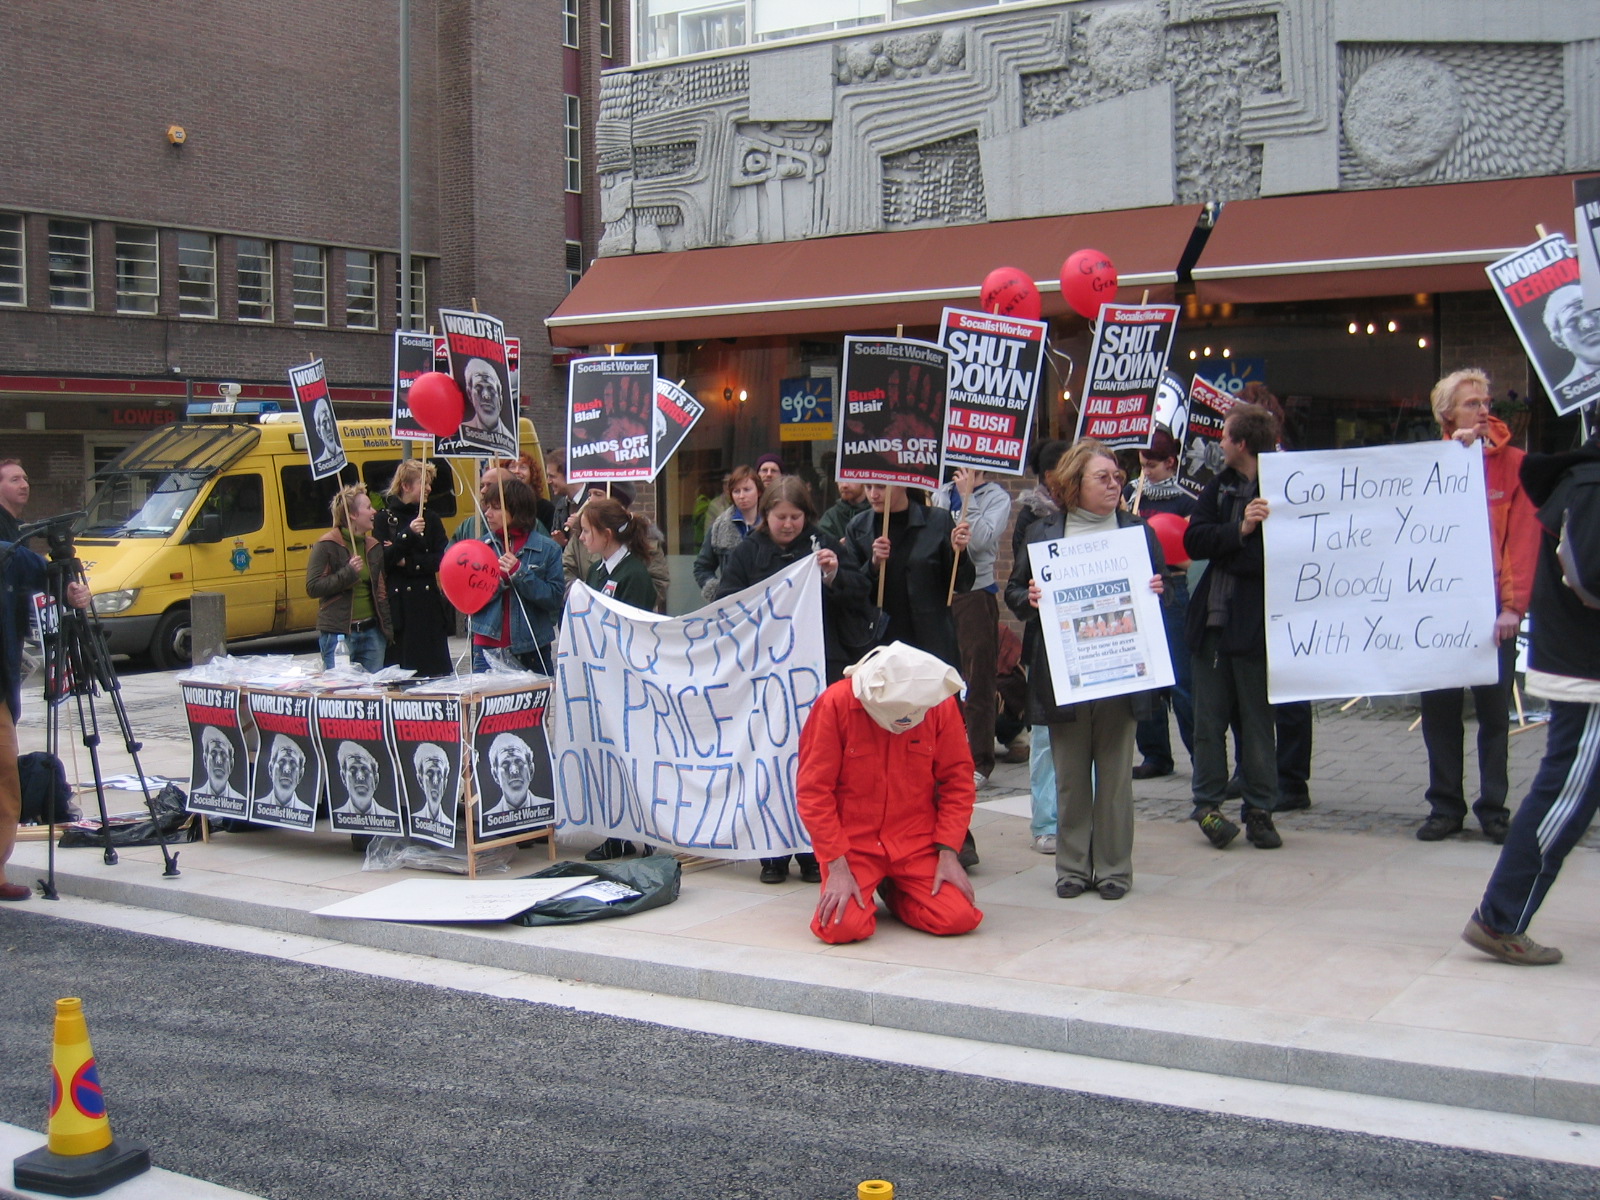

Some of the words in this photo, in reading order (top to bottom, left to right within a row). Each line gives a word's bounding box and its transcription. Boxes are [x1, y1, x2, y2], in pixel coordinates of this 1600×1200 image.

[445, 315, 493, 340] WORLD'S
[1101, 325, 1160, 353] SHUT
[855, 343, 903, 356] Socialist
[904, 345, 943, 363] Worker
[949, 331, 1026, 369] SHUT
[578, 362, 615, 373] Socialist
[616, 361, 649, 371] Worker
[1094, 352, 1163, 381] DOWN
[1141, 379, 1156, 388] BAY
[574, 398, 604, 412] Bush
[848, 388, 885, 402] Bush
[1007, 398, 1028, 410] BAY
[211, 403, 234, 413] POLICE
[574, 409, 601, 423] Blair
[683, 401, 698, 416] #1
[781, 391, 816, 422] ego
[849, 400, 883, 414] Blair
[1087, 399, 1112, 414] JAIL
[1116, 398, 1142, 414] BUSH
[113, 409, 177, 424] LOWER
[969, 413, 1010, 433] BUSH
[1090, 420, 1117, 435] AND
[1118, 418, 1148, 433] BLAIR
[1190, 413, 1211, 426] END
[343, 426, 374, 438] Caught
[377, 428, 387, 436] on
[363, 439, 389, 447] Mobile
[572, 440, 619, 458] HANDS
[622, 435, 648, 449] OFF
[844, 438, 903, 455] HANDS
[907, 438, 937, 451] OFF
[976, 437, 1021, 457] BLAIR
[615, 446, 649, 462] IRAN
[897, 451, 938, 466] IRAN
[871, 472, 896, 480] troops
[912, 474, 921, 482] of
[1284, 471, 1325, 505] Go
[1340, 466, 1412, 501] Home
[1423, 461, 1469, 496] And
[1298, 512, 1372, 552] Take
[1394, 505, 1460, 544] Your
[1048, 539, 1109, 559] REMEBER
[1041, 557, 1129, 583] GUANTANAMO
[1295, 561, 1392, 602] Bloody
[1407, 557, 1463, 593] War
[1055, 587, 1094, 603] DAILY
[1095, 581, 1128, 597] POST
[1287, 620, 1350, 657] With
[1414, 616, 1479, 649] Condi.
[184, 687, 222, 707] WORLD'S
[223, 692, 234, 709] #1
[251, 694, 293, 715] WORLD'S
[294, 699, 306, 717] #1
[485, 693, 532, 716] WORLD'S
[531, 690, 547, 708] #1
[186, 704, 237, 728] TERRORIST
[319, 700, 365, 719] WORLD'S
[367, 701, 380, 720] #1
[393, 701, 443, 720] WORLD'S
[446, 702, 459, 721] #1
[624, 669, 733, 758] PRICE
[254, 712, 309, 736] TERRORIST
[319, 719, 383, 741] TERRORIST
[394, 720, 459, 742] TERRORIST
[478, 707, 545, 735] TERRORIST
[553, 749, 755, 850] ONDOLEEZZA
